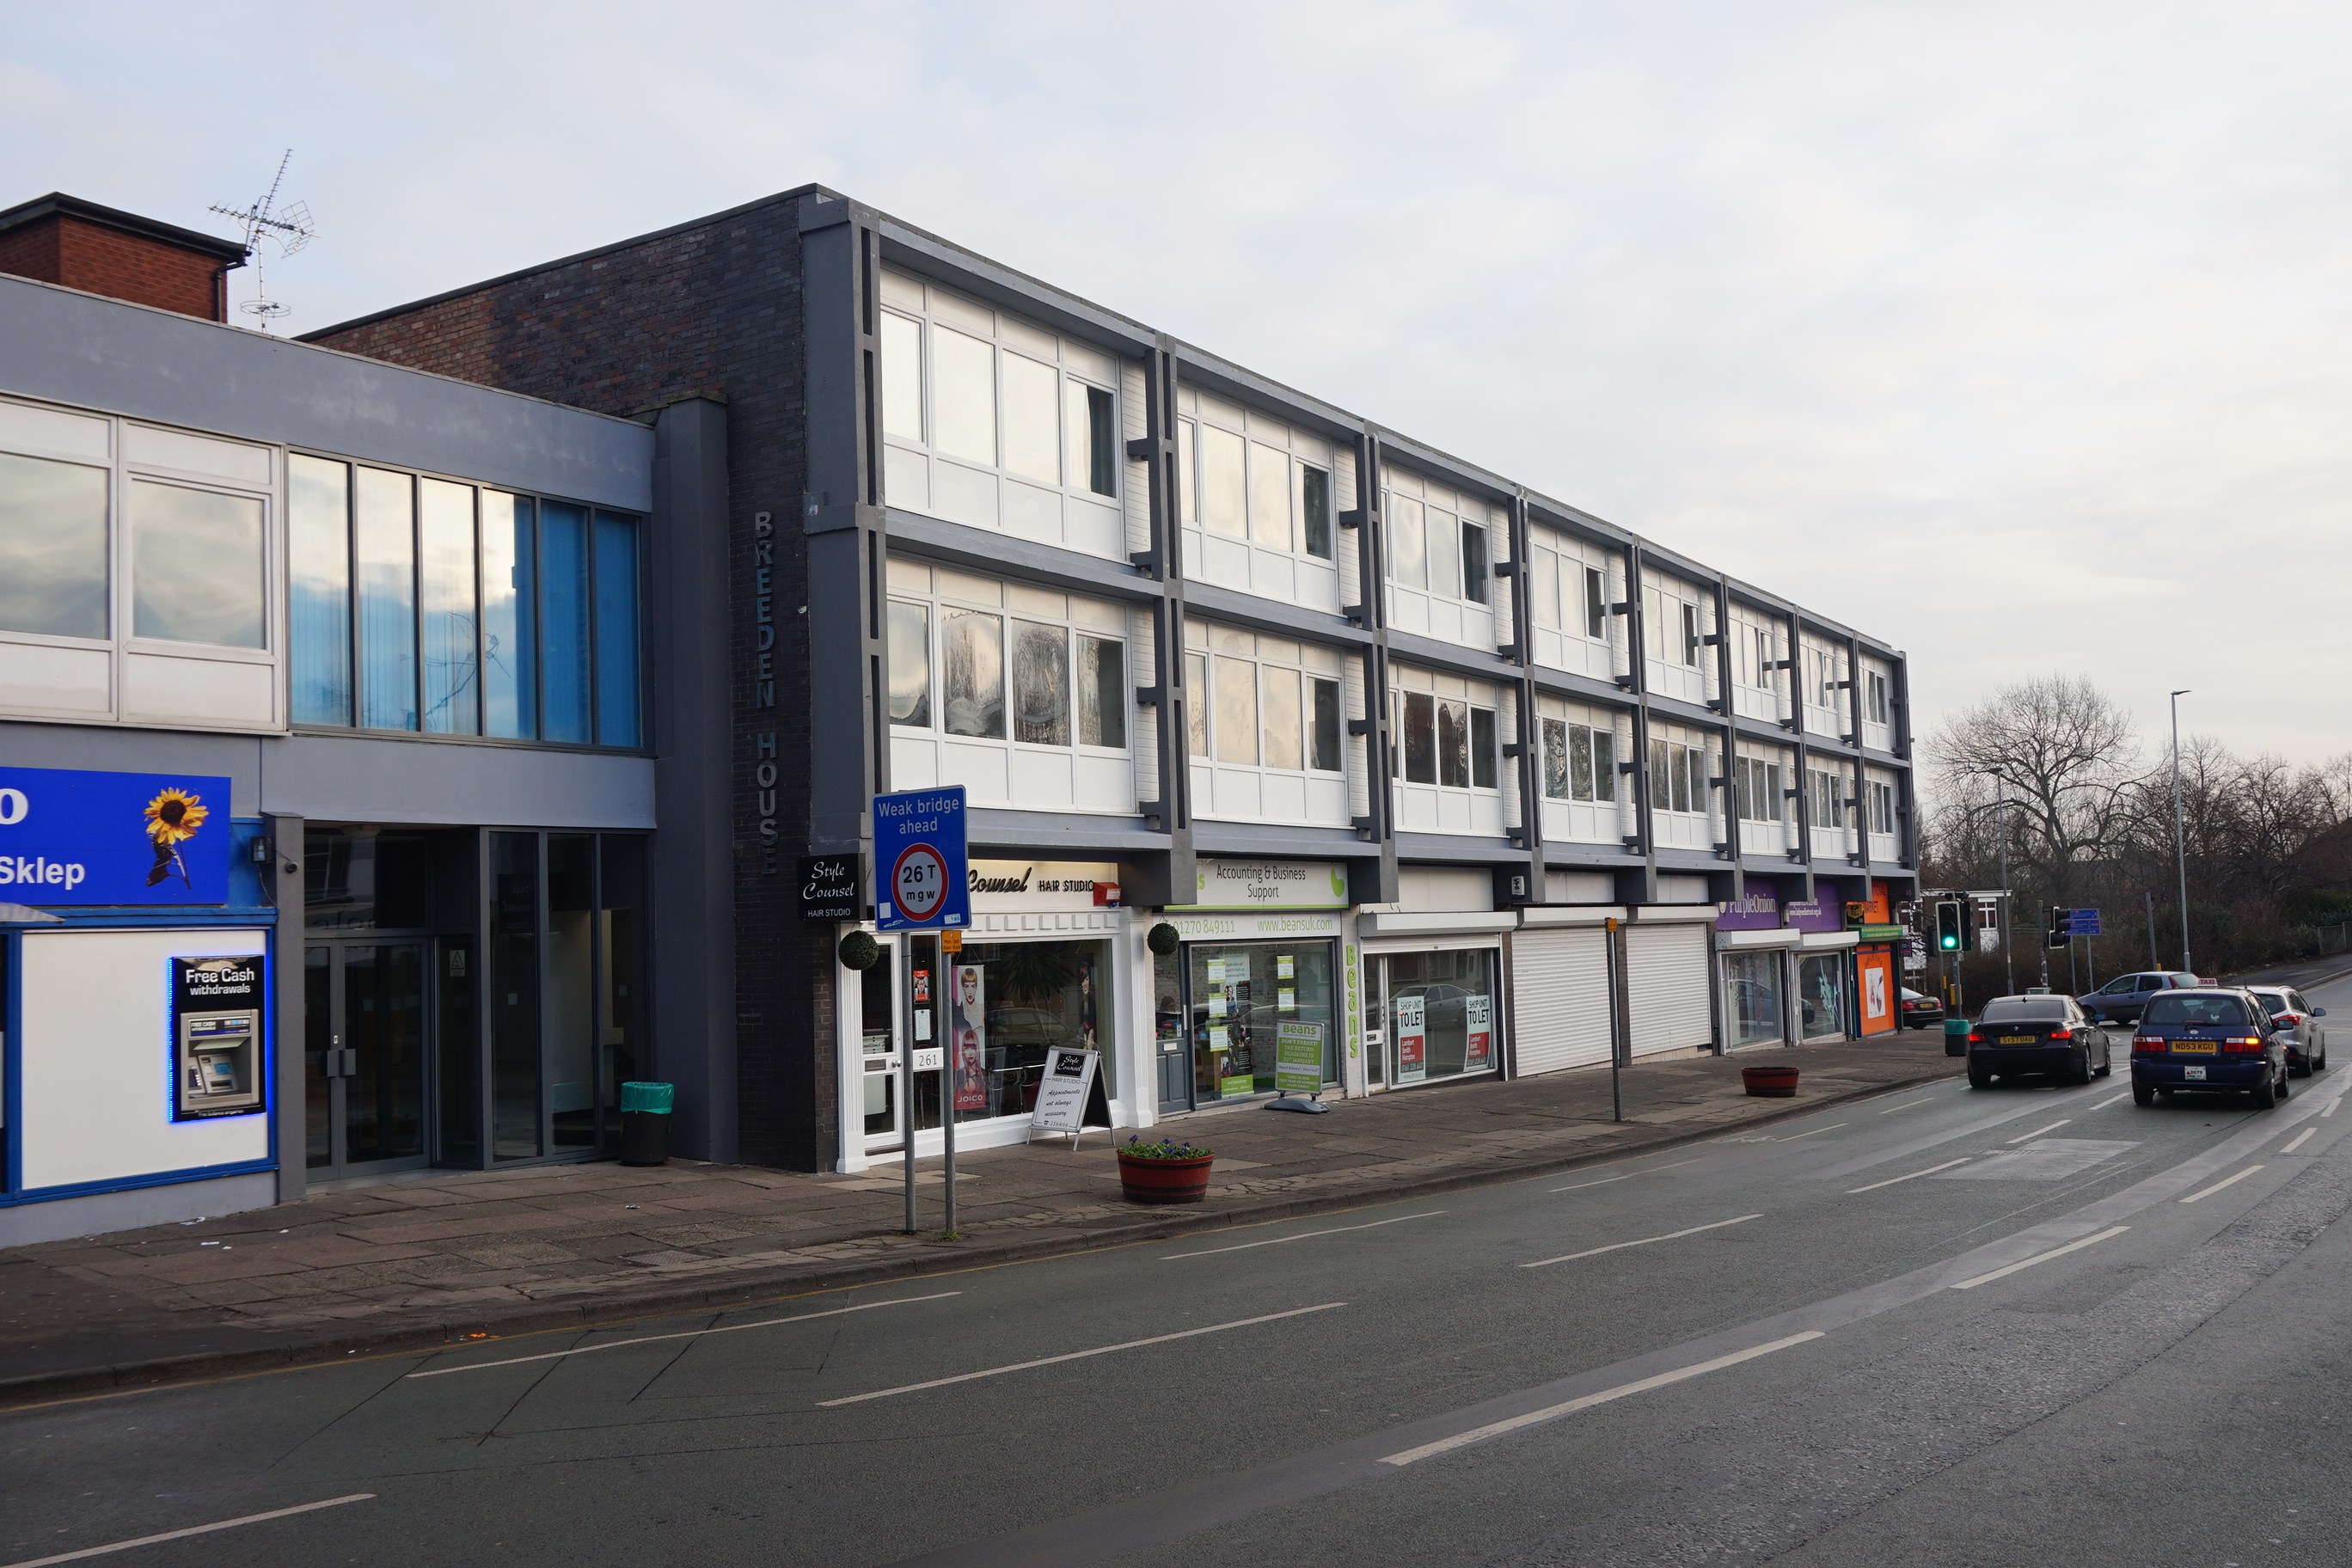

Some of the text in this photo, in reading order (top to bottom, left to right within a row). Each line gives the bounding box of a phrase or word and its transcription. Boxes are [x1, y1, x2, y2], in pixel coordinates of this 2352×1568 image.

[754, 511, 776, 707] BREEDEN
[878, 796, 959, 818] Weak bridge
[899, 817, 938, 835] ahead
[0, 855, 85, 891] Sklep
[811, 861, 845, 882] Style
[903, 864, 935, 884] 26 T
[968, 867, 1095, 893] Counsel HAIR STUDIO
[1216, 864, 1264, 884] Accounting
[1264, 865, 1271, 880] &
[1273, 866, 1307, 880] Business
[802, 882, 854, 900] Counsel
[1247, 883, 1279, 902] Support
[807, 907, 851, 918] HAIR STUDIO
[1173, 916, 1332, 934] 01270 849111 www.beansuk.com
[186, 967, 255, 983] Free Cash
[189, 983, 251, 995] withdrawals
[1345, 944, 1359, 1059] Beans
[1400, 1000, 1422, 1011] SHOP UNIT
[1468, 998, 1488, 1009] SHOP UNIT
[1400, 1010, 1424, 1027] TO LET
[1468, 1009, 1490, 1025] TO LET
[1283, 1024, 1317, 1035] Beans
[919, 1053, 938, 1067] 261
[1057, 1063, 1082, 1072] Counsel
[1063, 1056, 1080, 1065] Style
[958, 1094, 983, 1103] JOICO
[1046, 1088, 1081, 1097] Appointments
